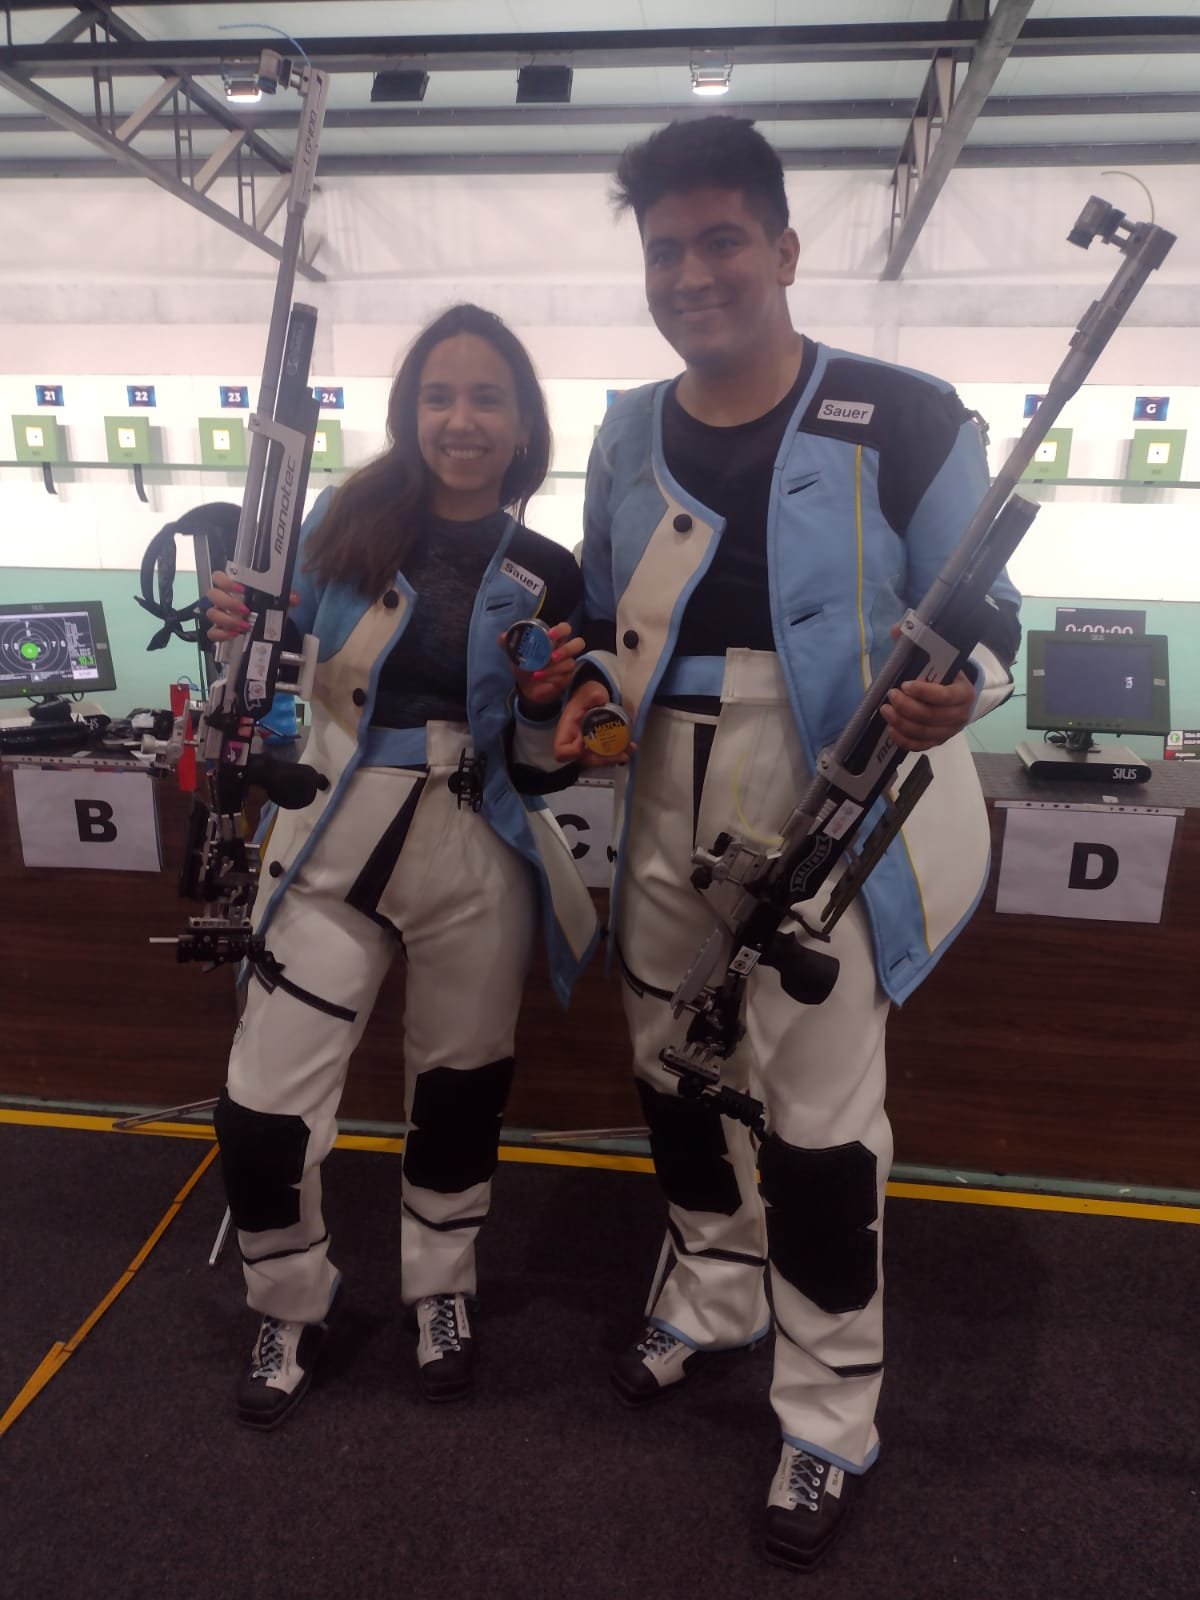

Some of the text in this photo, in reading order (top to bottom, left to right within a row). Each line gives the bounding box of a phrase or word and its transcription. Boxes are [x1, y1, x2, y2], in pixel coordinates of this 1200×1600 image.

[44, 391, 56, 401] 21
[135, 391, 148, 401] 22
[228, 392, 241, 402] 23
[322, 393, 337, 403] 24
[823, 404, 868, 420] Sauer
[1146, 404, 1157, 414] G
[275, 456, 296, 556] monotec
[503, 562, 540, 591] Sauer
[1113, 768, 1137, 780] SIUS
[74, 799, 117, 842] B
[554, 813, 590, 860] C
[1067, 842, 1119, 890] D
